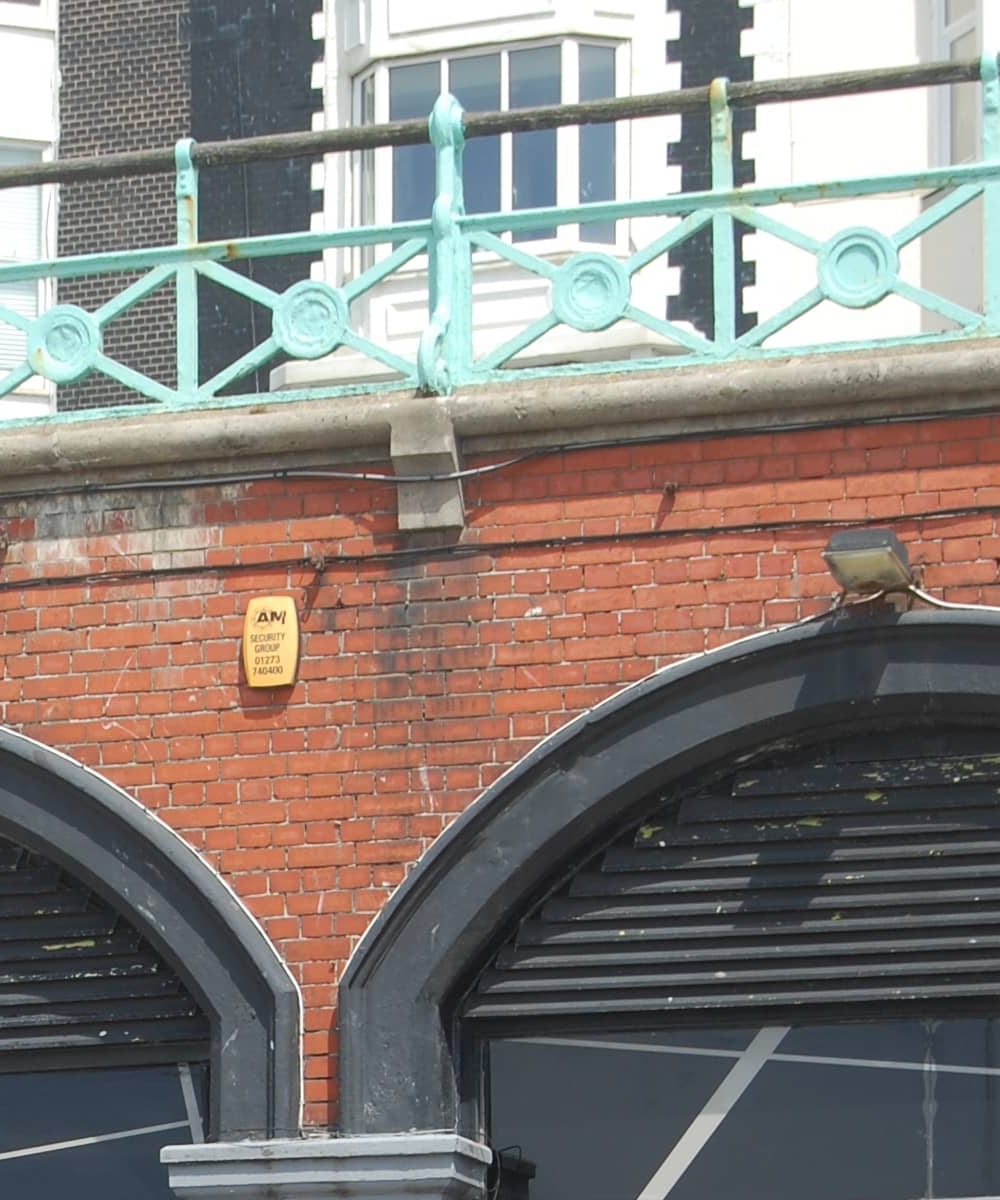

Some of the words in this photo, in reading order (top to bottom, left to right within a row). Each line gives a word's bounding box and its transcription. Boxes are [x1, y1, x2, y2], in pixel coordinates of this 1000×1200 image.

[250, 633, 285, 643] SECURITY
[254, 643, 280, 653] GROUP
[254, 655, 280, 665] 01273
[253, 666, 283, 676] 740400
